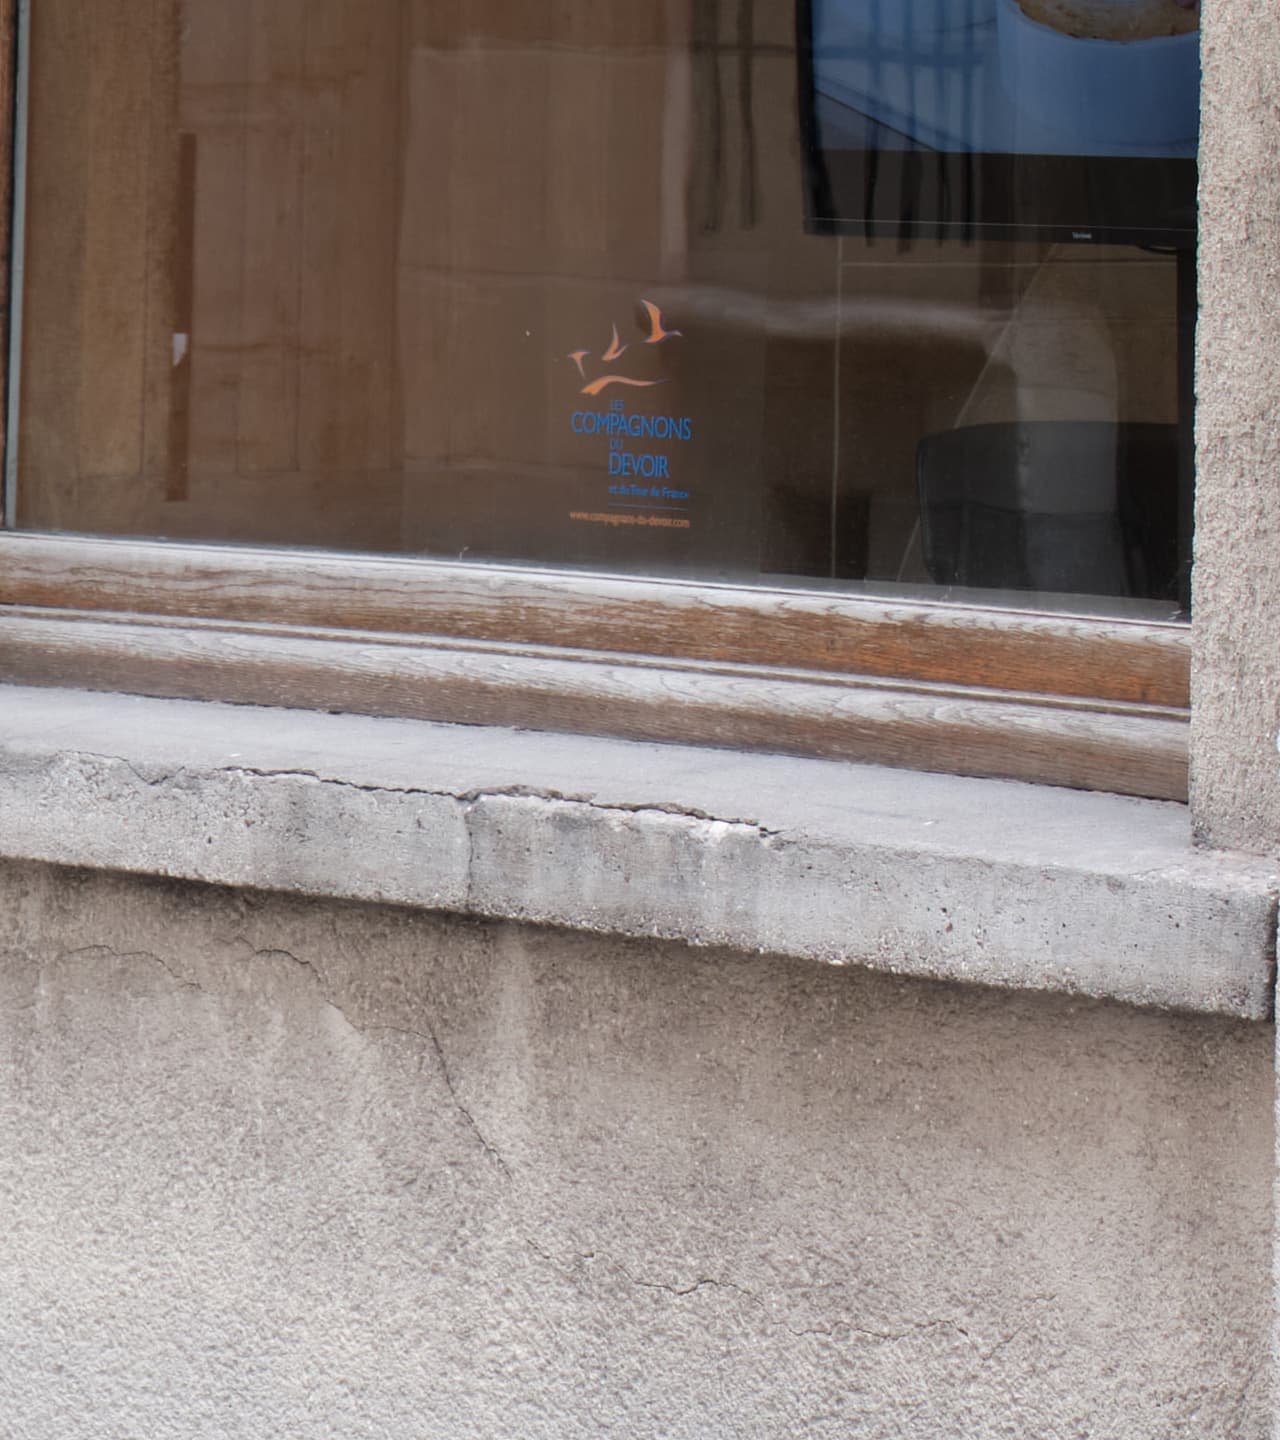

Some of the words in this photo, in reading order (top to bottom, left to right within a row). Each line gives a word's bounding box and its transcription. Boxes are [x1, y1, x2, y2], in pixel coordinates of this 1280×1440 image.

[610, 399, 625, 411] LES
[571, 411, 692, 440] COMPAGNONS
[609, 439, 624, 450] DU
[608, 452, 670, 478] DEVOIR
